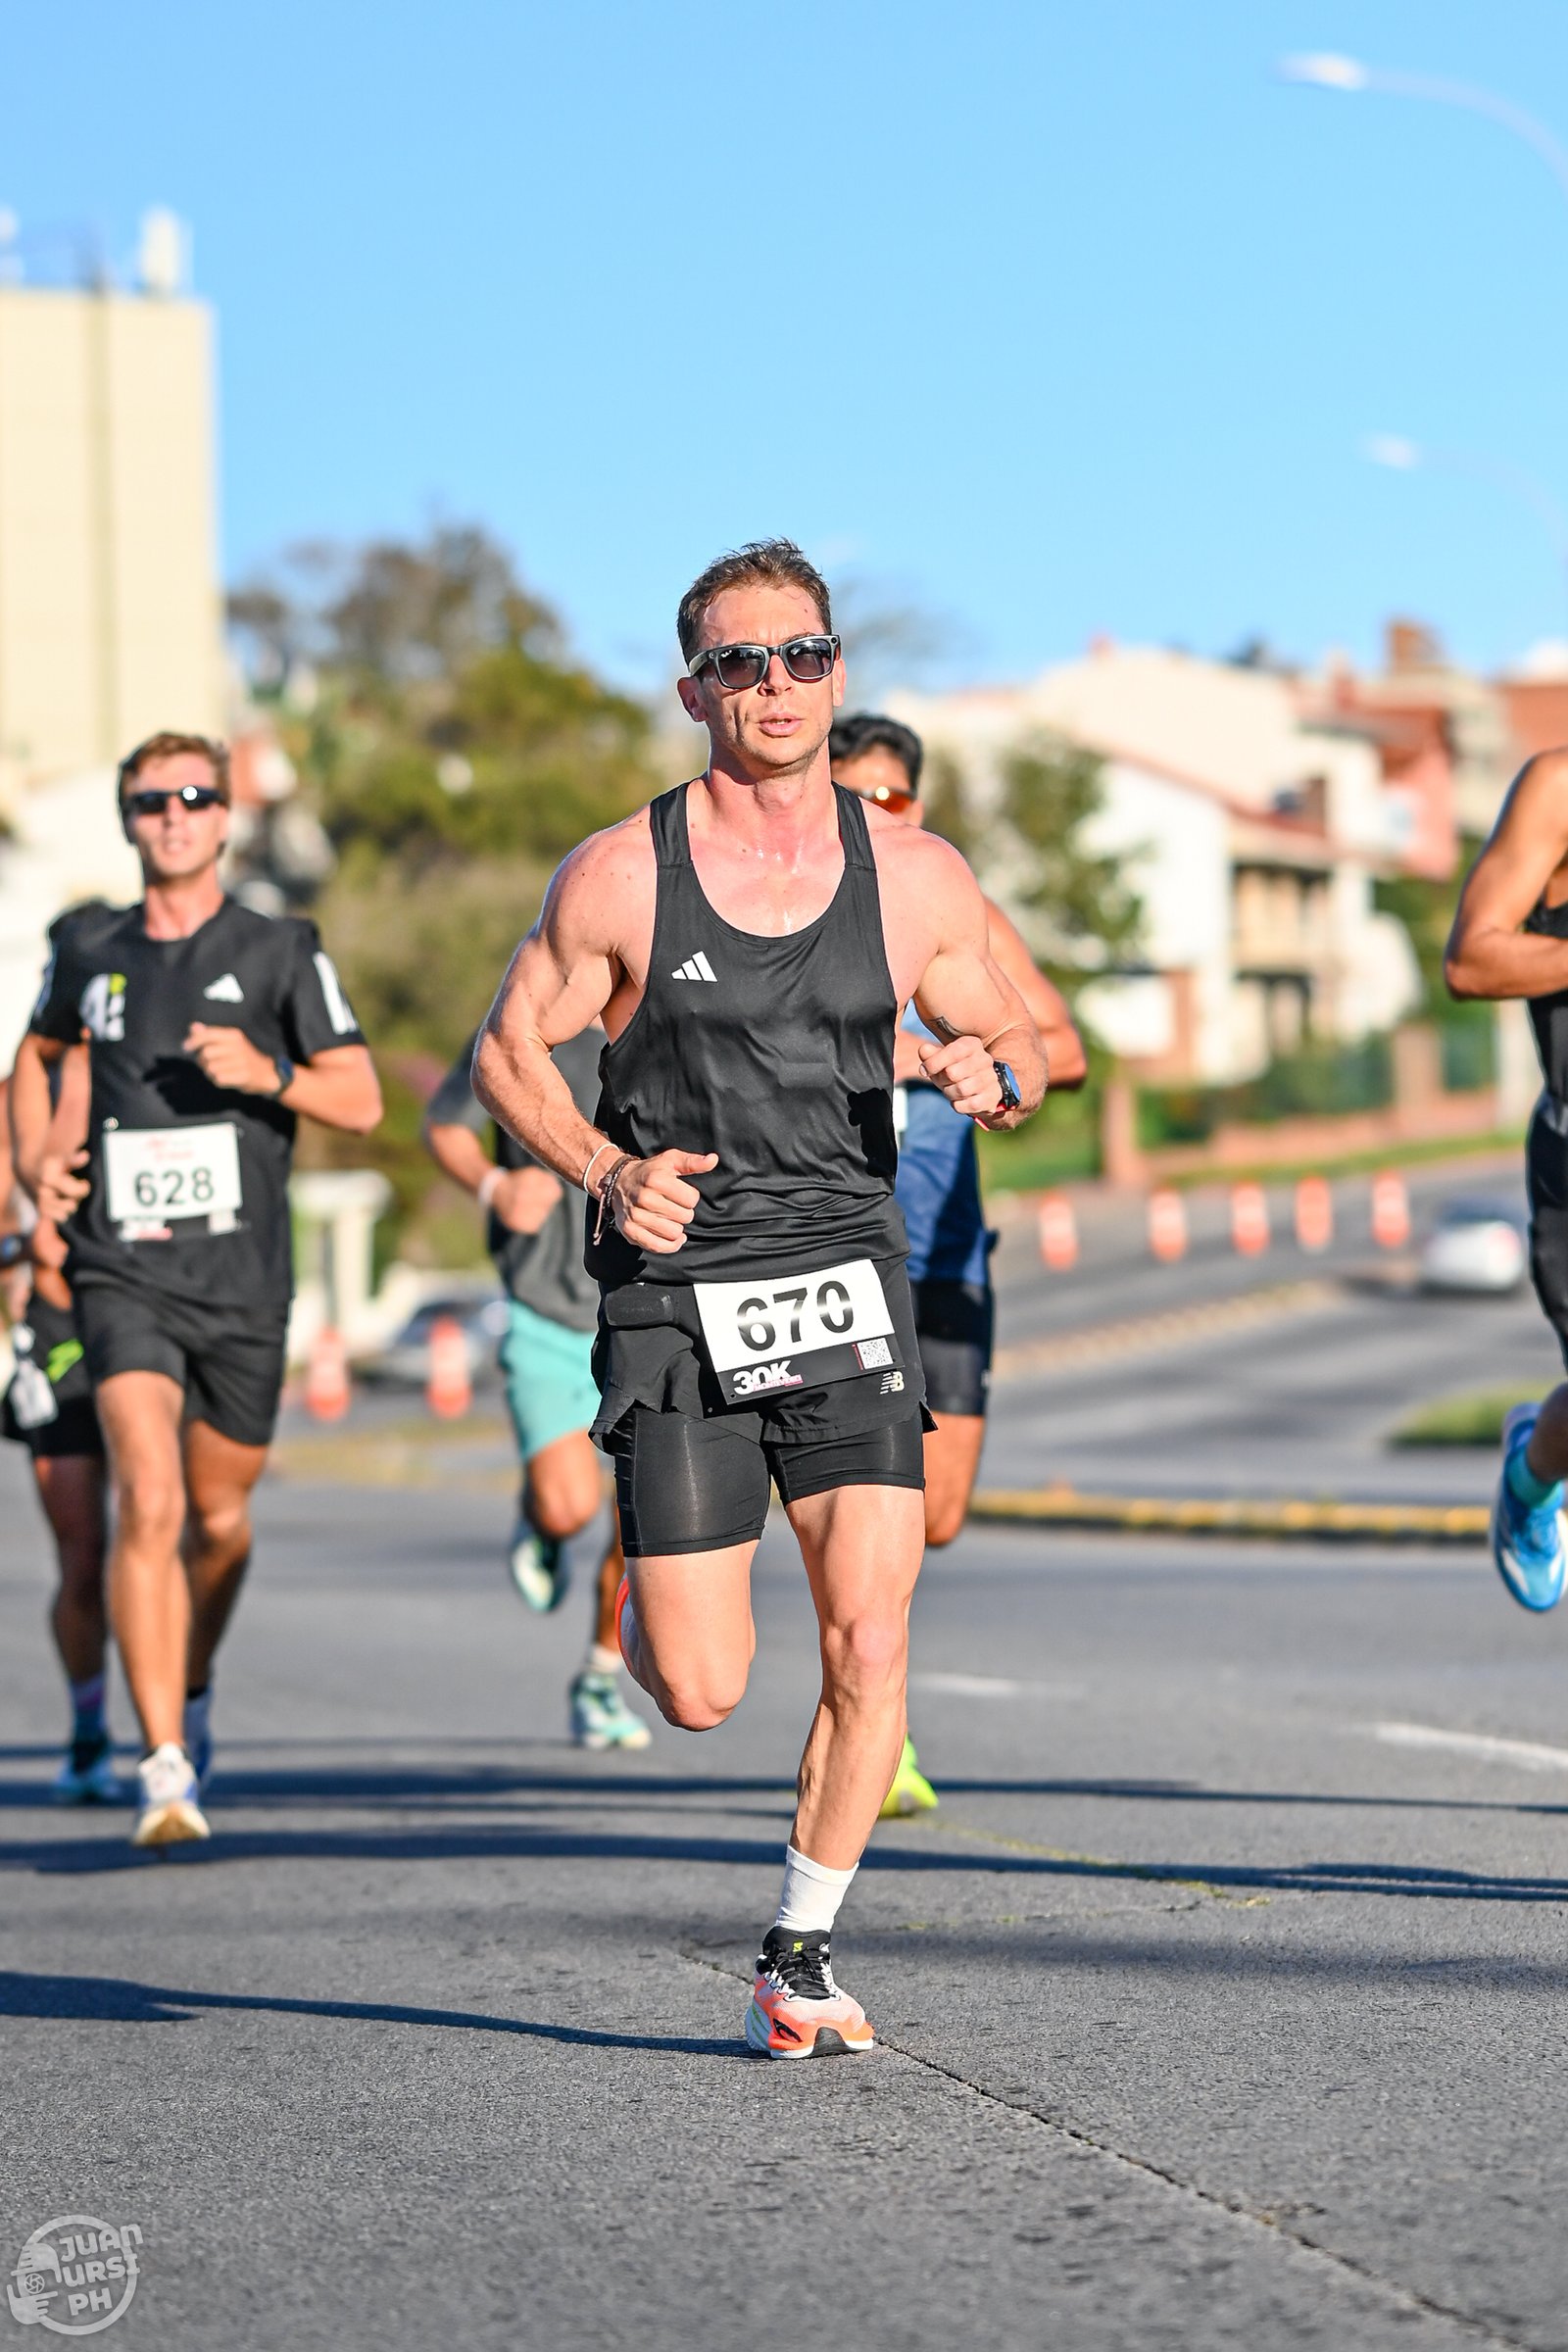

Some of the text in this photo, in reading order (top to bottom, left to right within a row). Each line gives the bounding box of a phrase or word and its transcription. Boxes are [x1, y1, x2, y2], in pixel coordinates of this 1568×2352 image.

[133, 1166, 215, 1207] 628
[737, 1281, 855, 1351] 670
[733, 1360, 791, 1395] 30K
